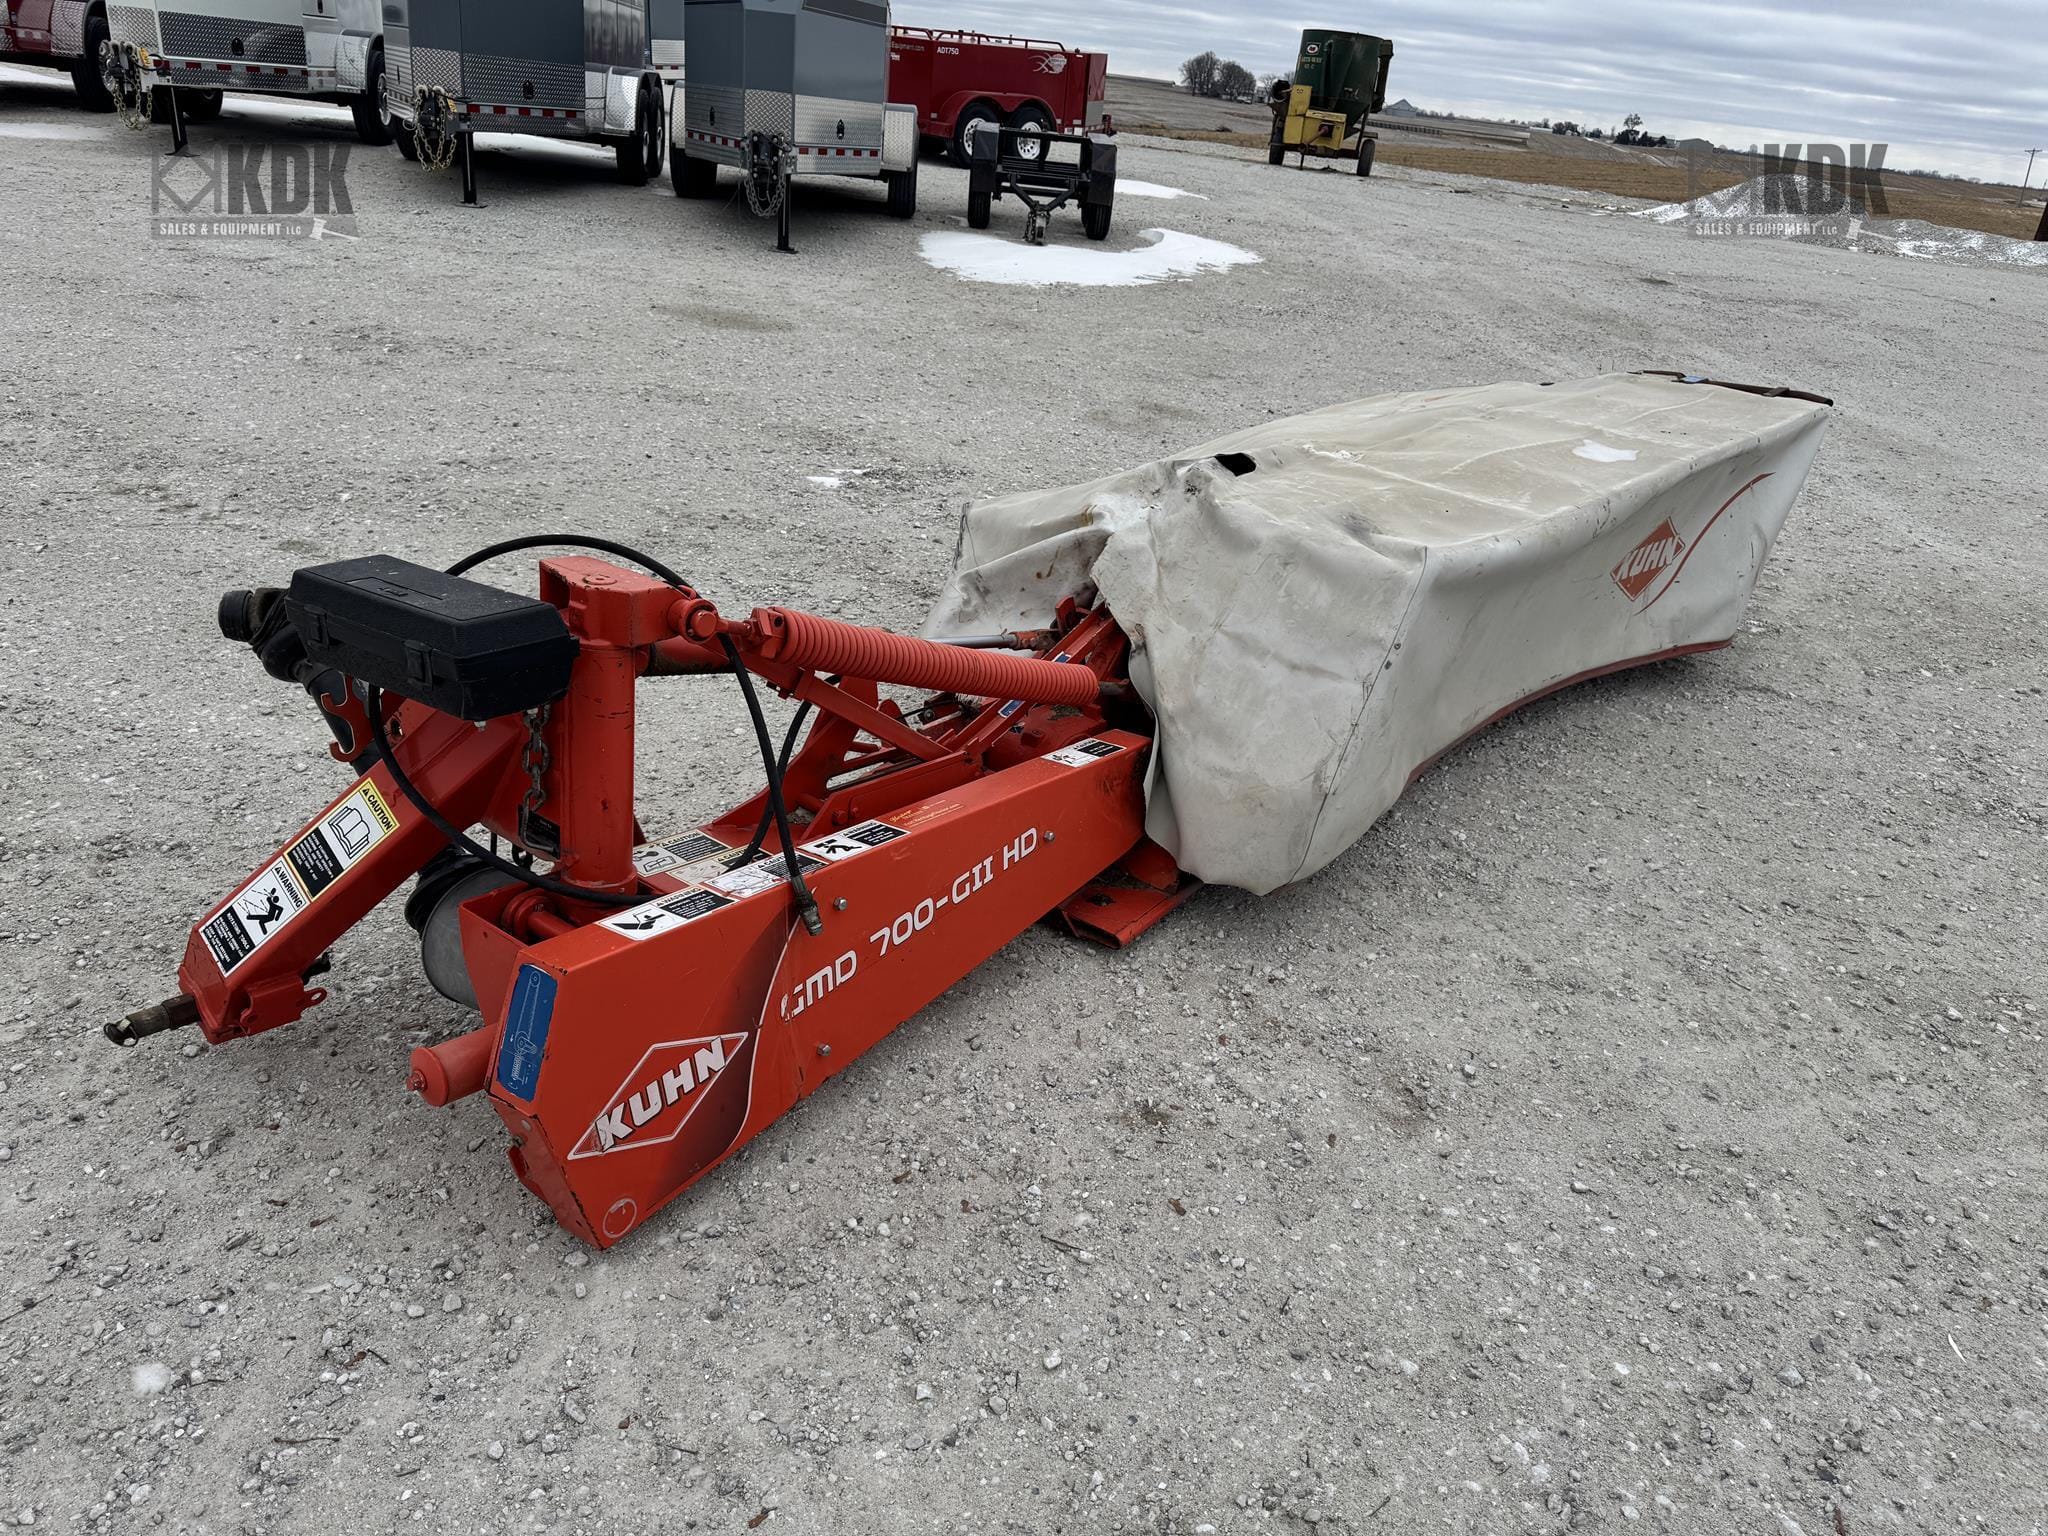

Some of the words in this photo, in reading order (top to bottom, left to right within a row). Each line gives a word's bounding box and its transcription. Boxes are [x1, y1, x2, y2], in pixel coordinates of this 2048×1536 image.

[936, 46, 959, 55] ADT750
[1615, 536, 1680, 581] KUHN
[367, 794, 393, 831] CAUTION
[668, 832, 700, 846] CAUTION
[280, 870, 303, 908] WARNING
[781, 949, 857, 1022] GMD
[869, 855, 994, 957] 700-GII
[1003, 827, 1038, 871] HD
[595, 1035, 727, 1153] KUHN
